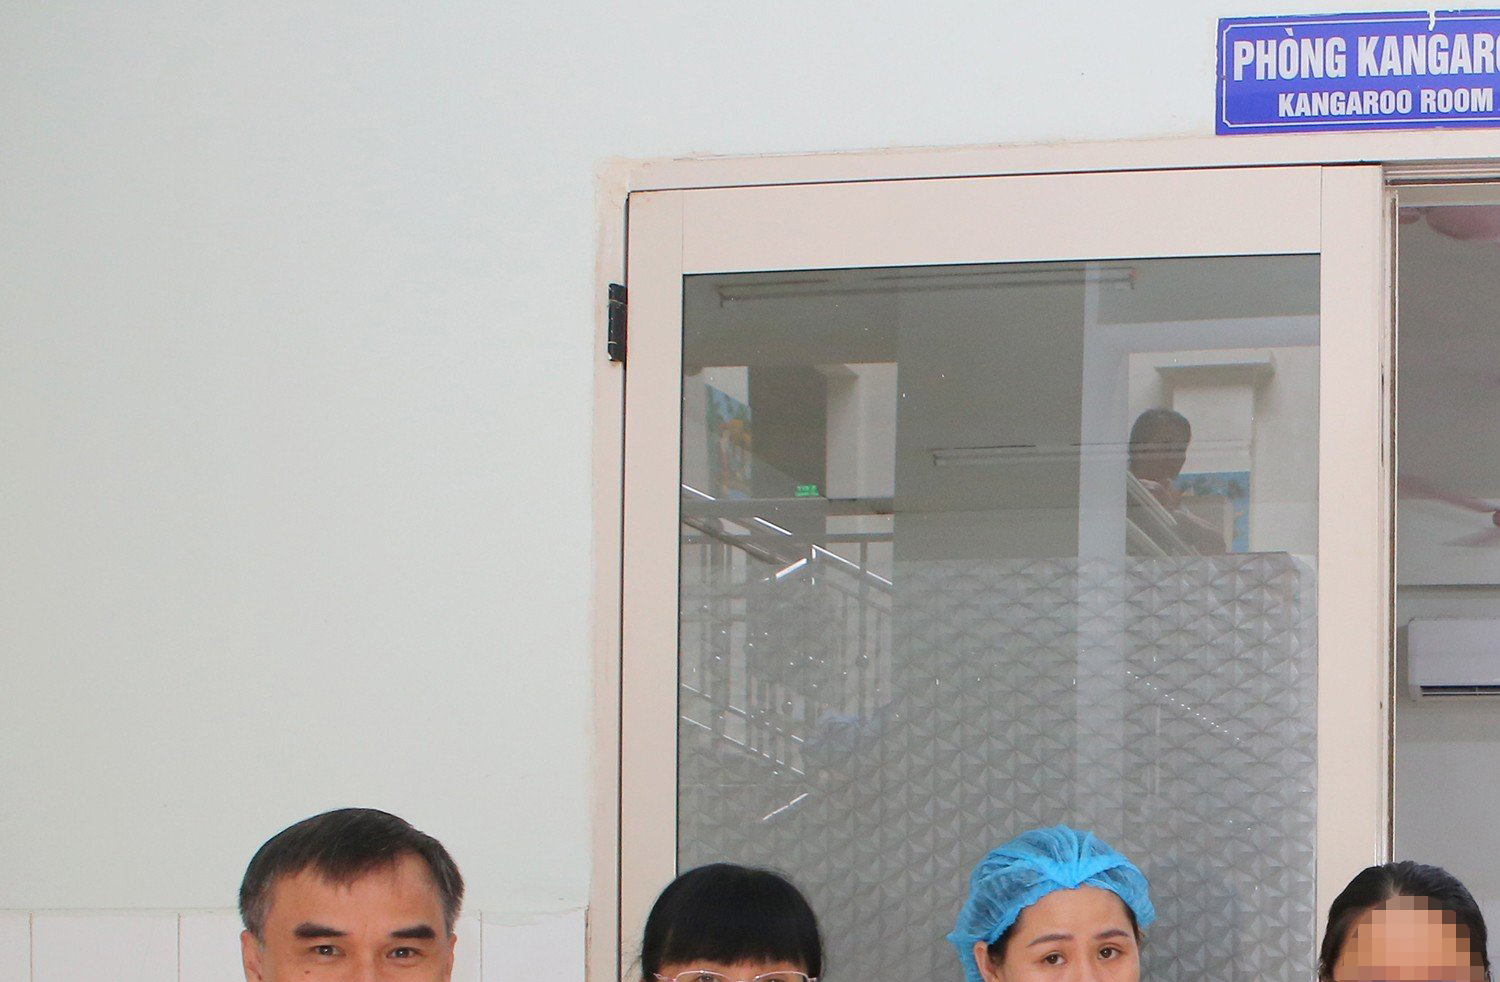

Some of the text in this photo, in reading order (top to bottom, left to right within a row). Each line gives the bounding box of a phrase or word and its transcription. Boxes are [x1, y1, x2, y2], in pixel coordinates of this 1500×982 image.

[1233, 28, 1347, 81] PHÒNG
[1278, 88, 1493, 117] KANGAROO ROOM
